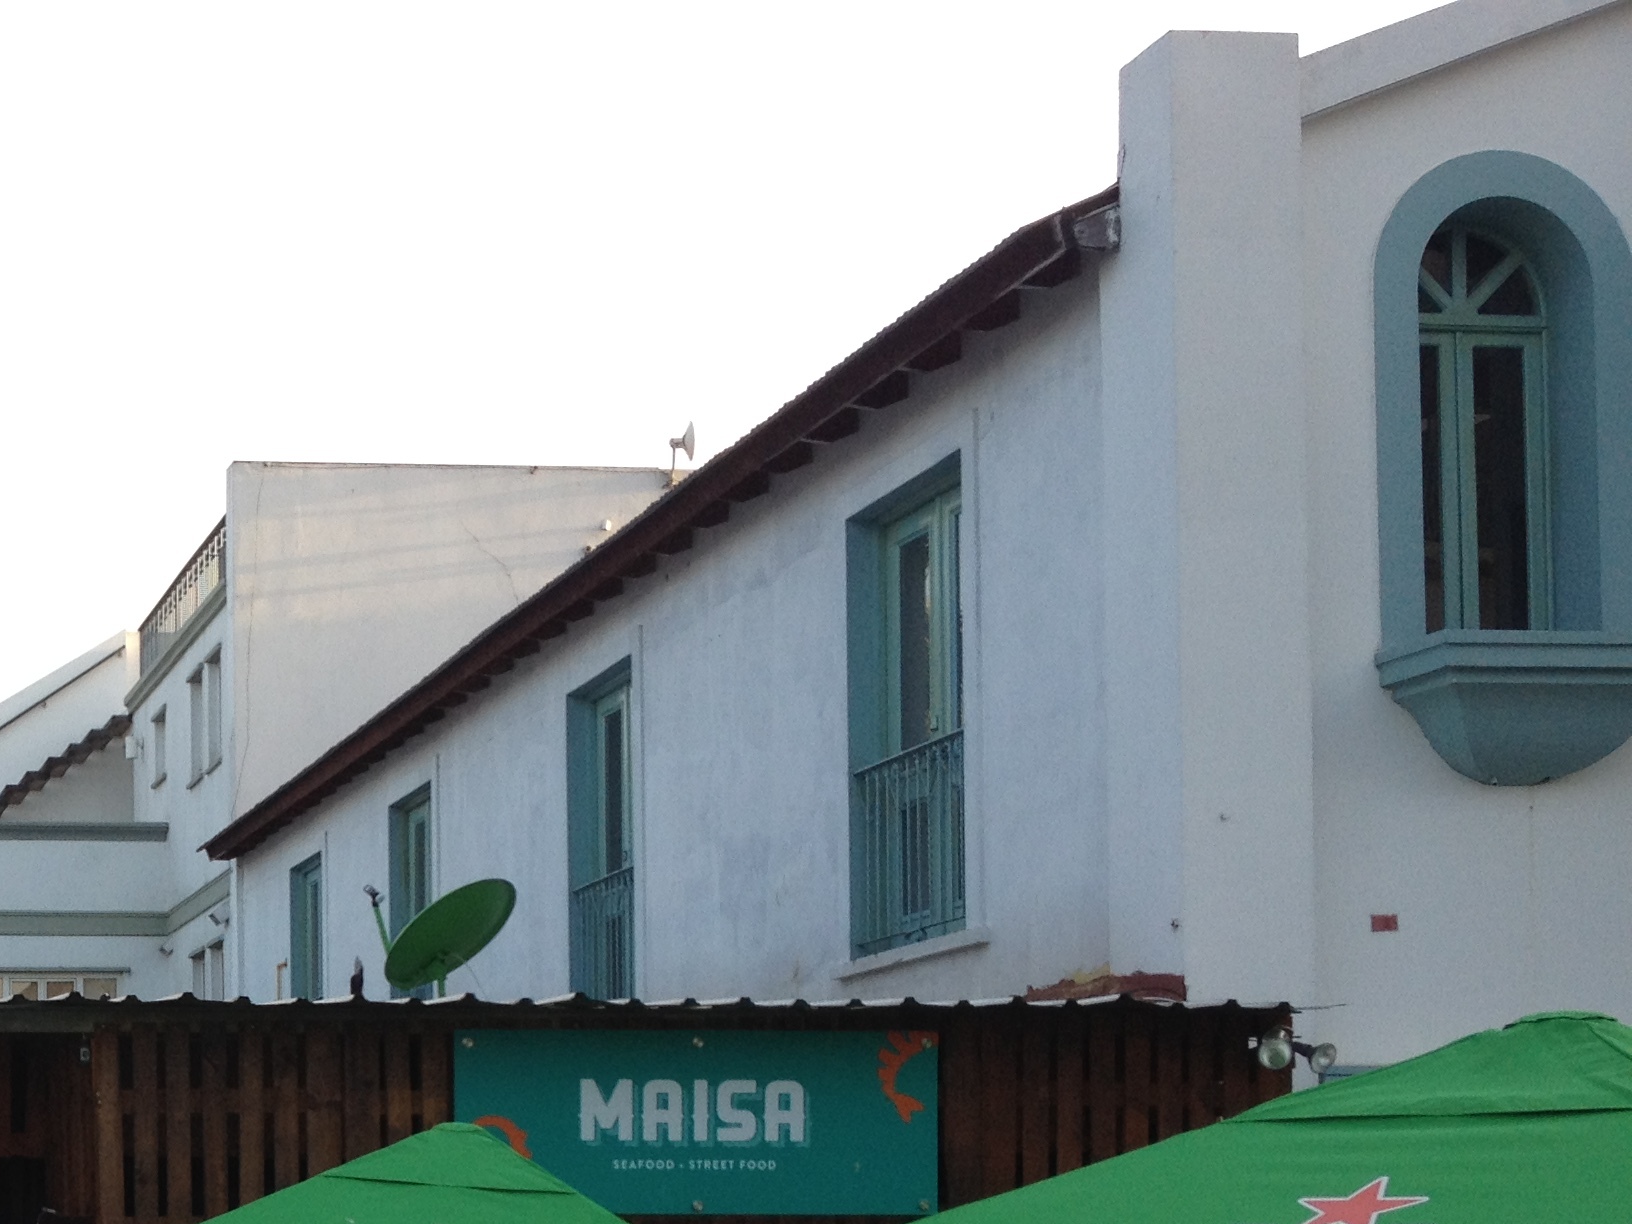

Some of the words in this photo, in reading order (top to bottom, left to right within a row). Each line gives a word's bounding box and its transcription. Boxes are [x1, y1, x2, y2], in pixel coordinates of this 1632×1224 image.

[578, 1078, 808, 1147] MAISA
[612, 1159, 675, 1170] SEAFOOD
[689, 1159, 735, 1170] STREET
[739, 1160, 777, 1171] FOOD
